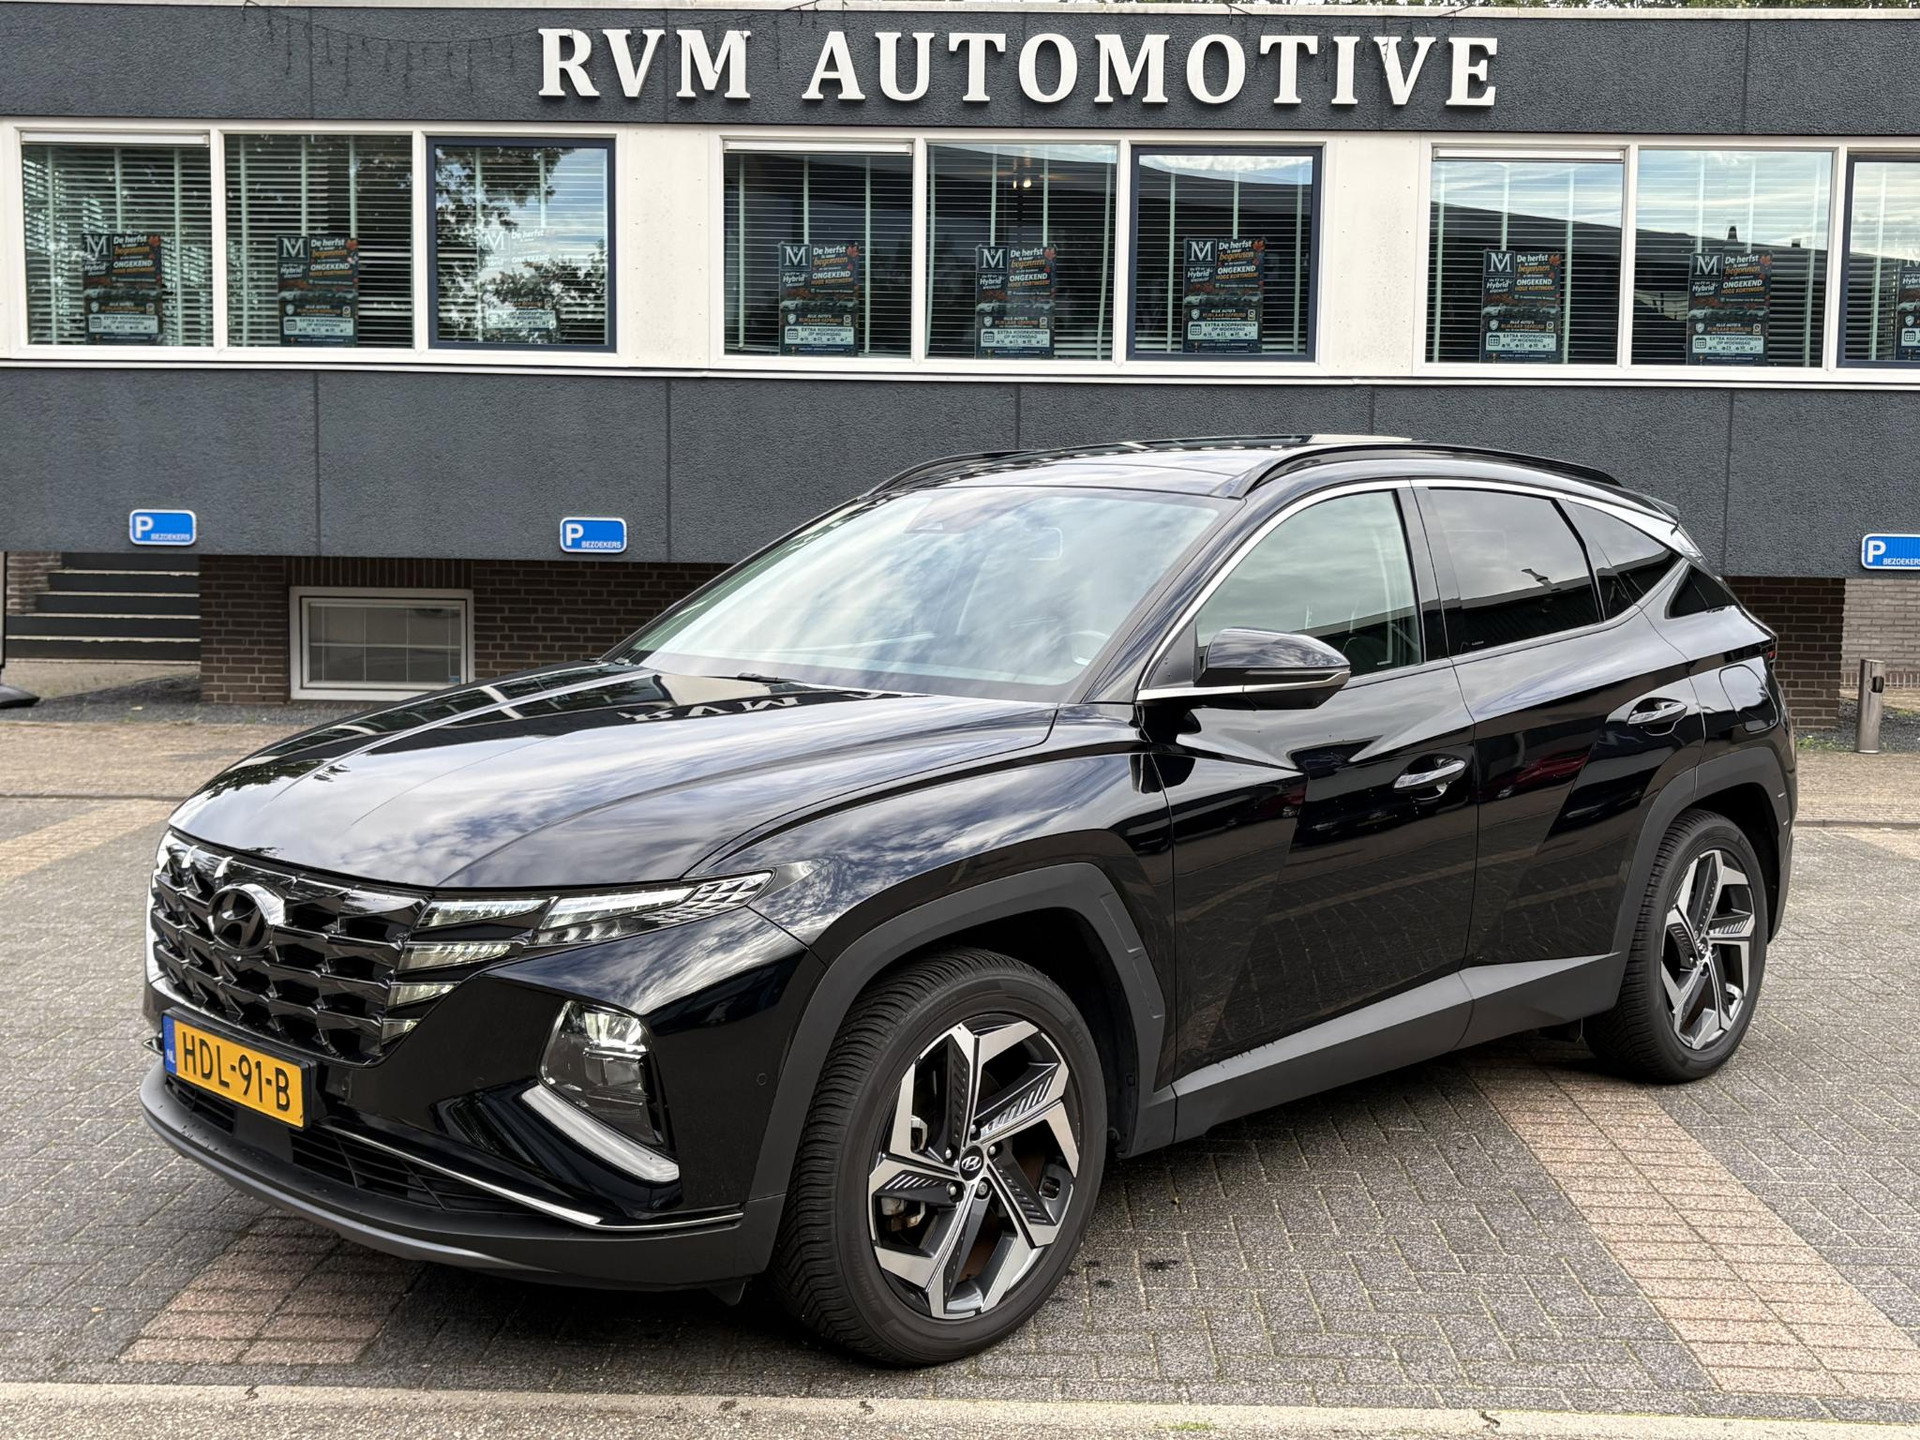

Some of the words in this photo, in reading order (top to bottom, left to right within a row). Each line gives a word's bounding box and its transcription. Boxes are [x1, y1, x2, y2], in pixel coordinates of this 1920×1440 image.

[537, 28, 752, 99] RVM
[801, 31, 1498, 106] AUTOMOTIVE
[1219, 242, 1229, 250] De
[1230, 241, 1252, 249] herfst
[1022, 248, 1043, 256] herfst
[1518, 255, 1527, 263] De
[1528, 254, 1548, 263] herfst
[1736, 255, 1758, 263] herfst
[1218, 265, 1256, 274] ONGEKEND
[1010, 273, 1047, 282] ONGEKEND
[1188, 271, 1210, 279] Hybrid
[1516, 278, 1553, 287] ONGEKEND
[1723, 280, 1762, 289] ONGEKEND
[1902, 277, 1920, 285] Hybri
[135, 516, 153, 538] P
[566, 523, 584, 546] P
[1867, 540, 1886, 563] P
[182, 1031, 291, 1112] HDL-91-B
